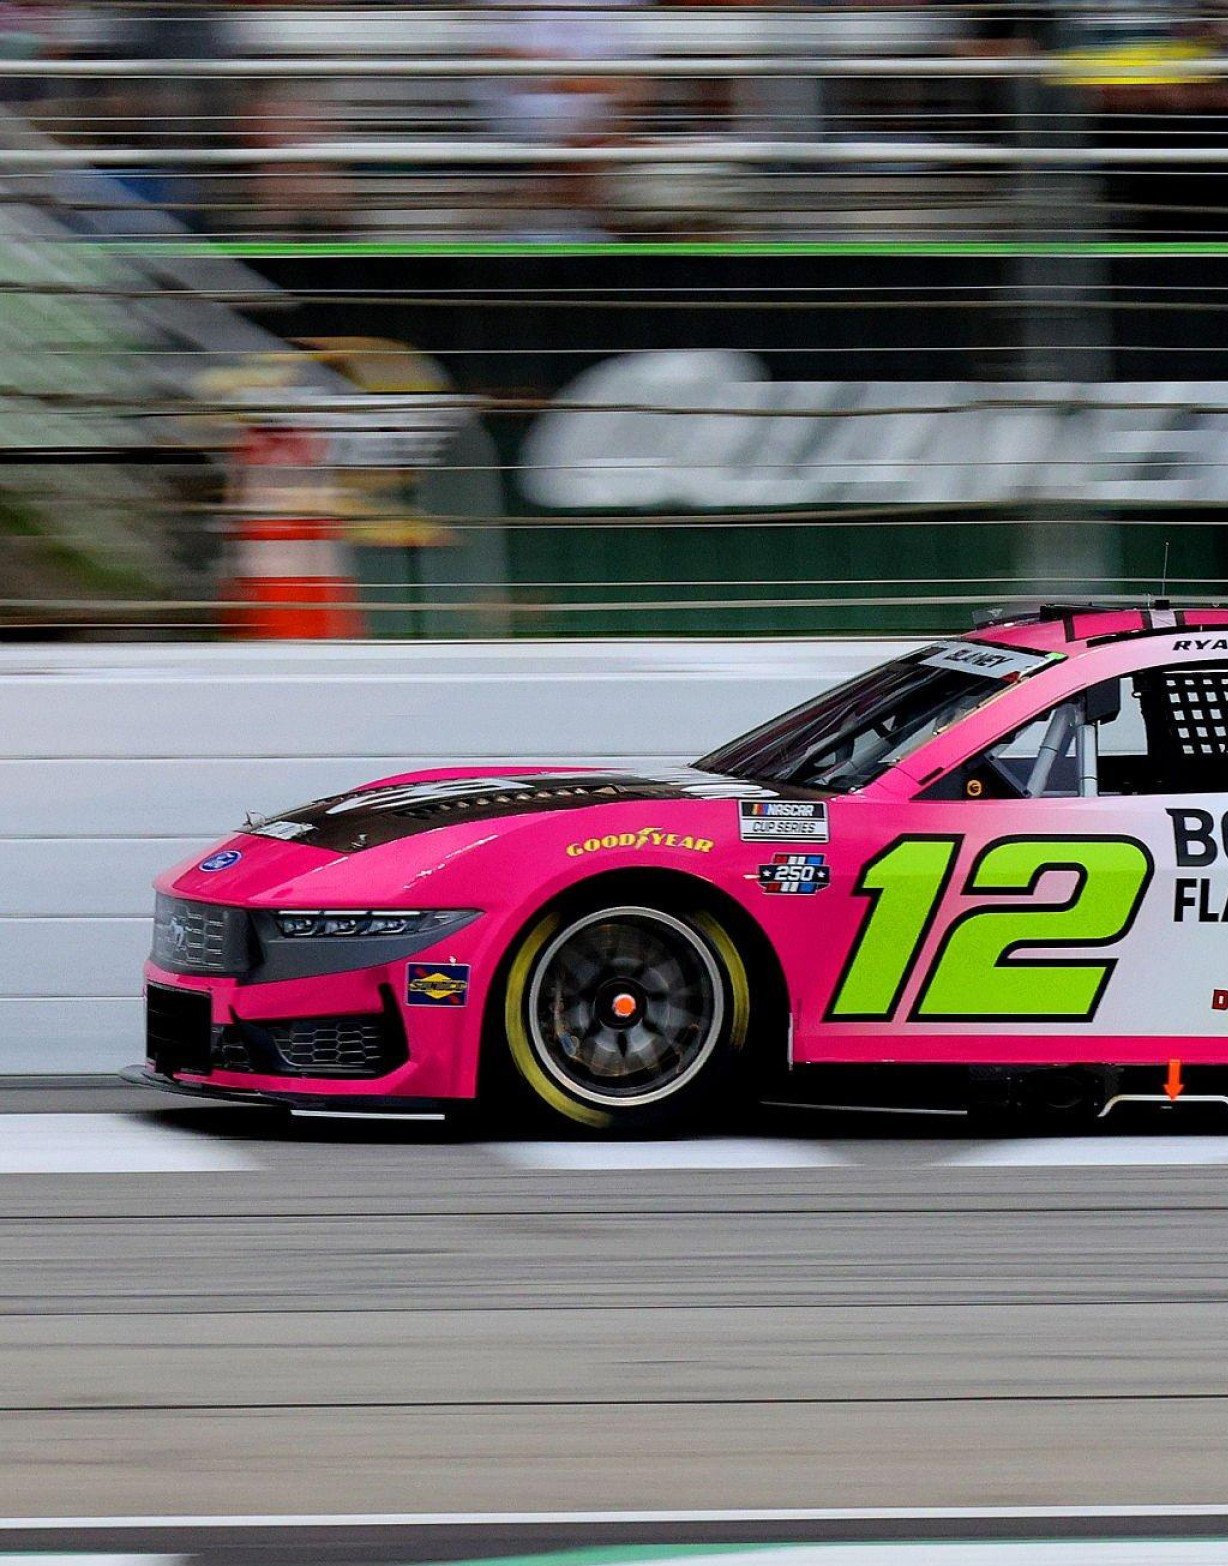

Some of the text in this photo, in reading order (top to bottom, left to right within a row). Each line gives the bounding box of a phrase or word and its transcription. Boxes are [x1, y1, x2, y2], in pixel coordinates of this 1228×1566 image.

[767, 804, 814, 817] NASCAR
[752, 821, 817, 833] CUP SERIES
[566, 827, 714, 857] GOODYEAR
[774, 866, 814, 881] 250
[821, 833, 1155, 1023] 12
